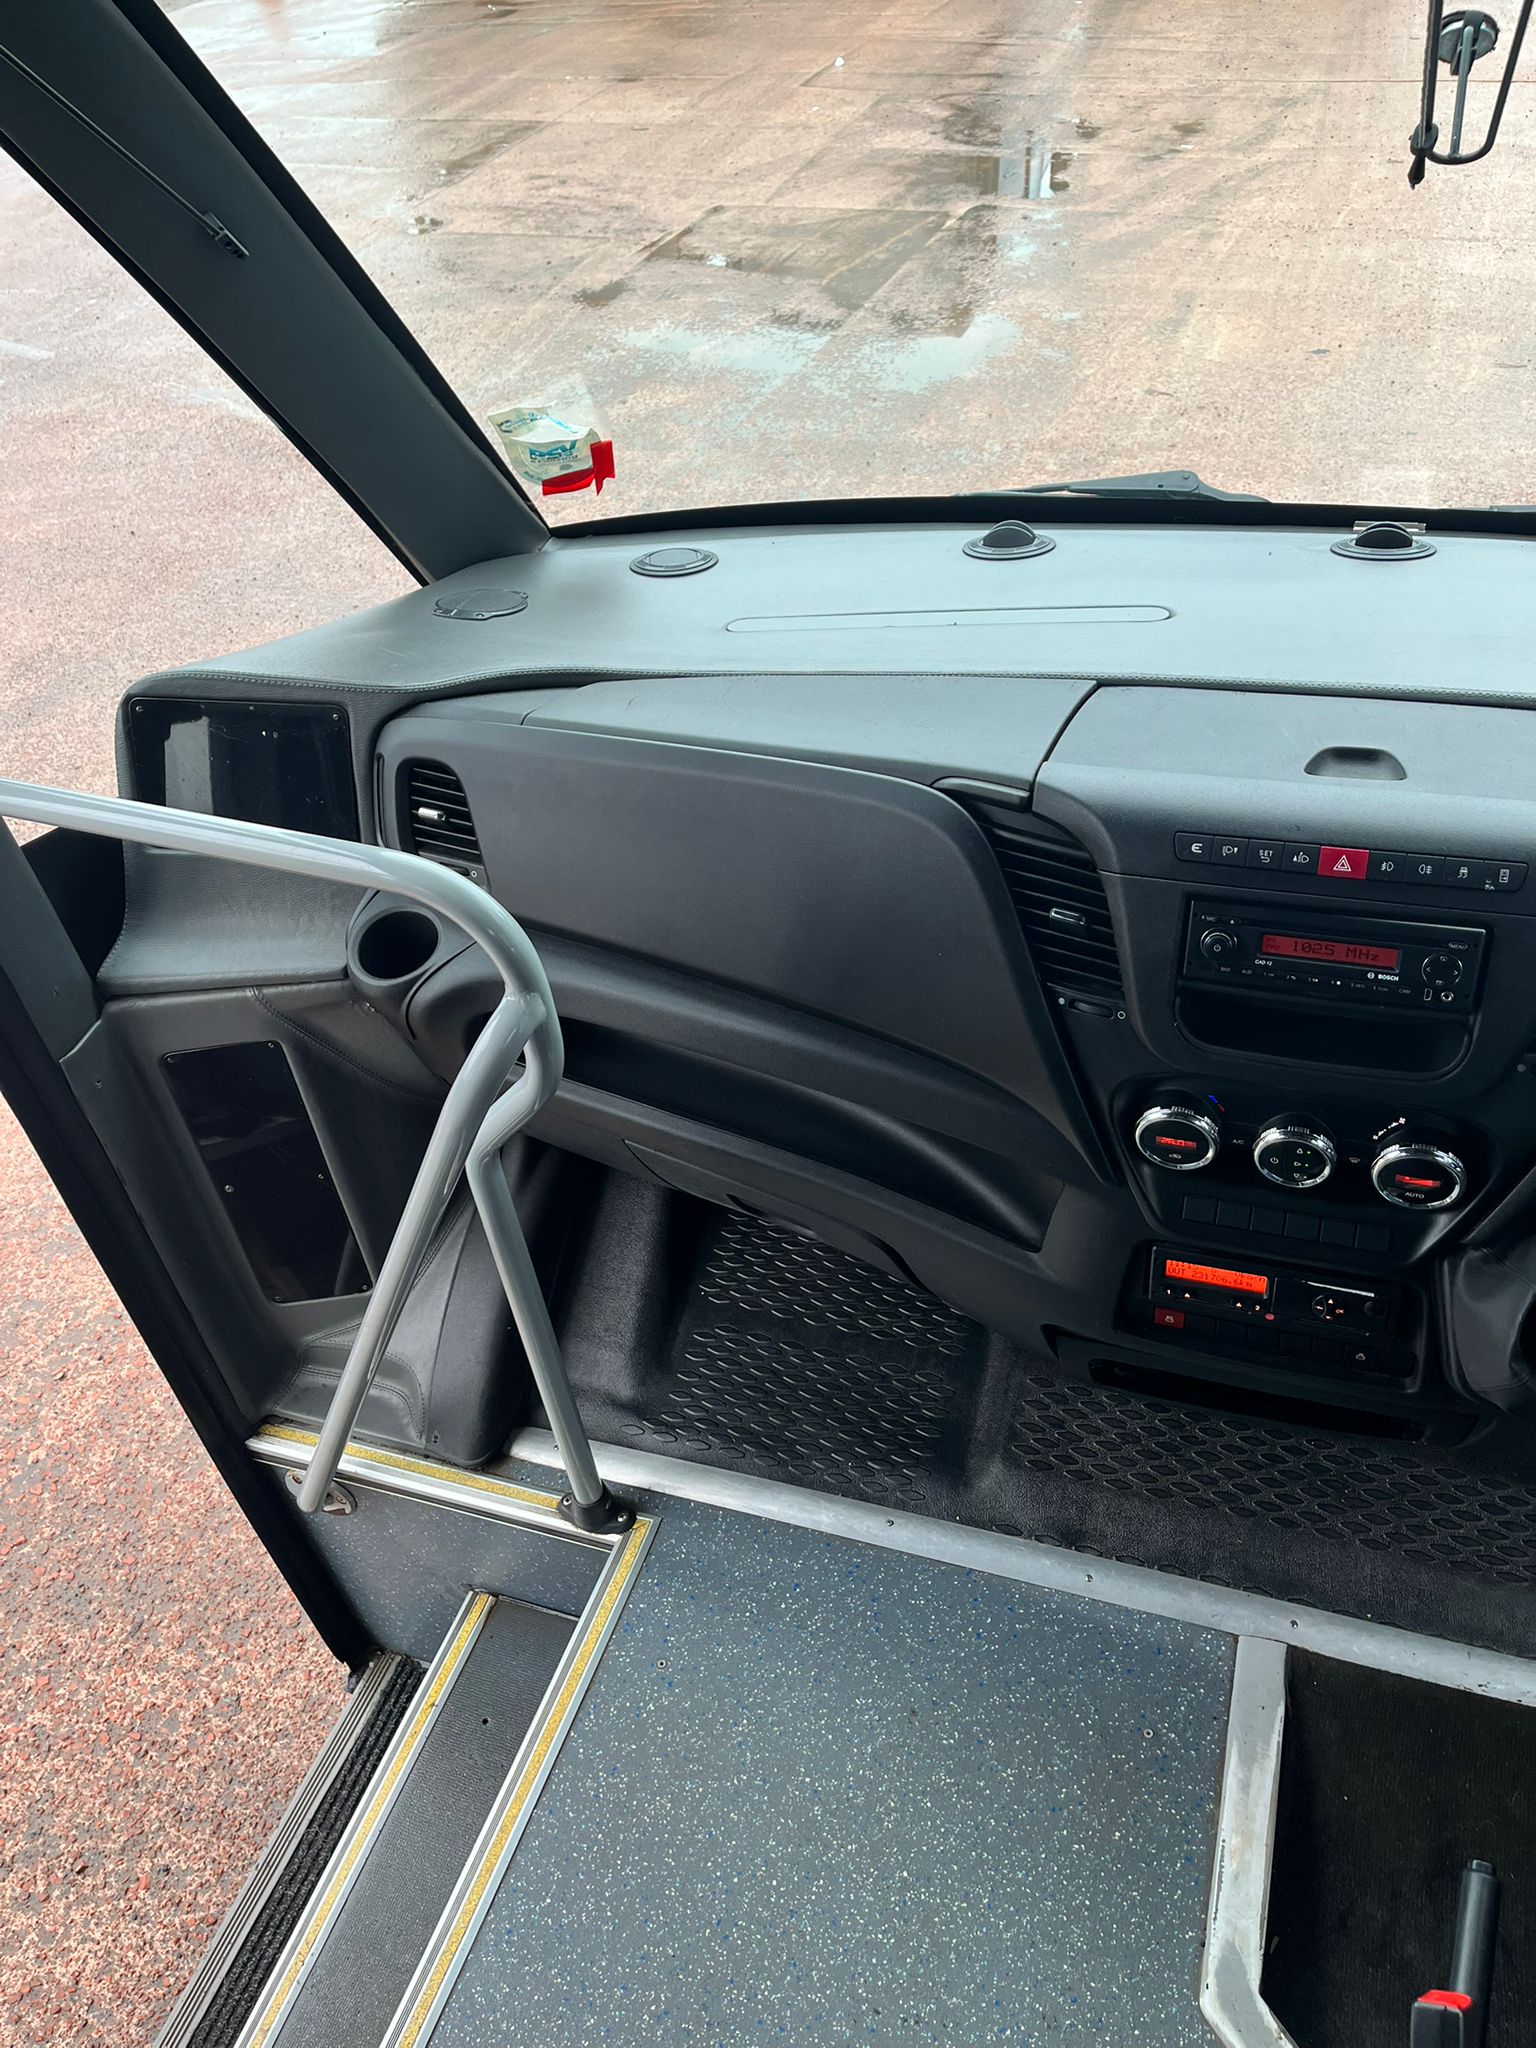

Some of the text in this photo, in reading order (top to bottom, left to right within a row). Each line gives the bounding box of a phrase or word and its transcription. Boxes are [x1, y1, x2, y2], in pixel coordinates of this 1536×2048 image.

[1259, 849, 1274, 857] SET
[1293, 940, 1379, 961] 1025 MHz
[1377, 973, 1399, 982] BOSCH
[1404, 1191, 1425, 1200] AUTO
